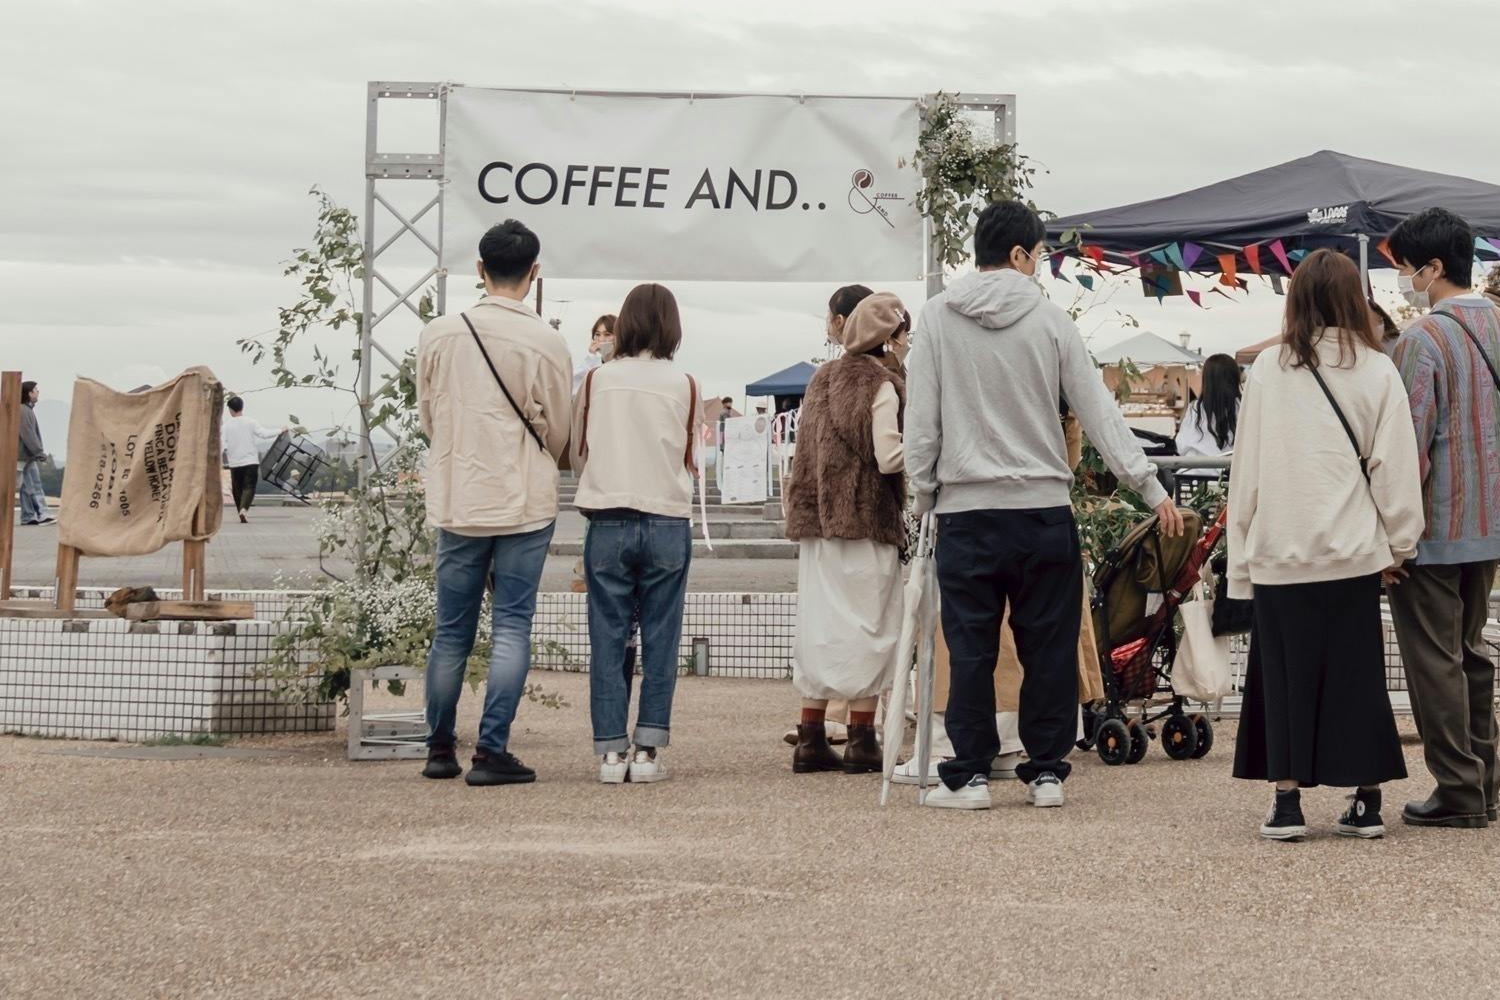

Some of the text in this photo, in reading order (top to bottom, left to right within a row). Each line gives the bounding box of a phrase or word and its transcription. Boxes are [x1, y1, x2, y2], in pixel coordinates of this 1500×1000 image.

[477, 161, 671, 209] COFFEE
[124, 434, 138, 460] LOT
[154, 423, 166, 458] FINCA
[164, 422, 176, 462] DON
[144, 441, 155, 475] YELLOW
[157, 458, 168, 492] BELLA
[119, 489, 131, 517] 1005
